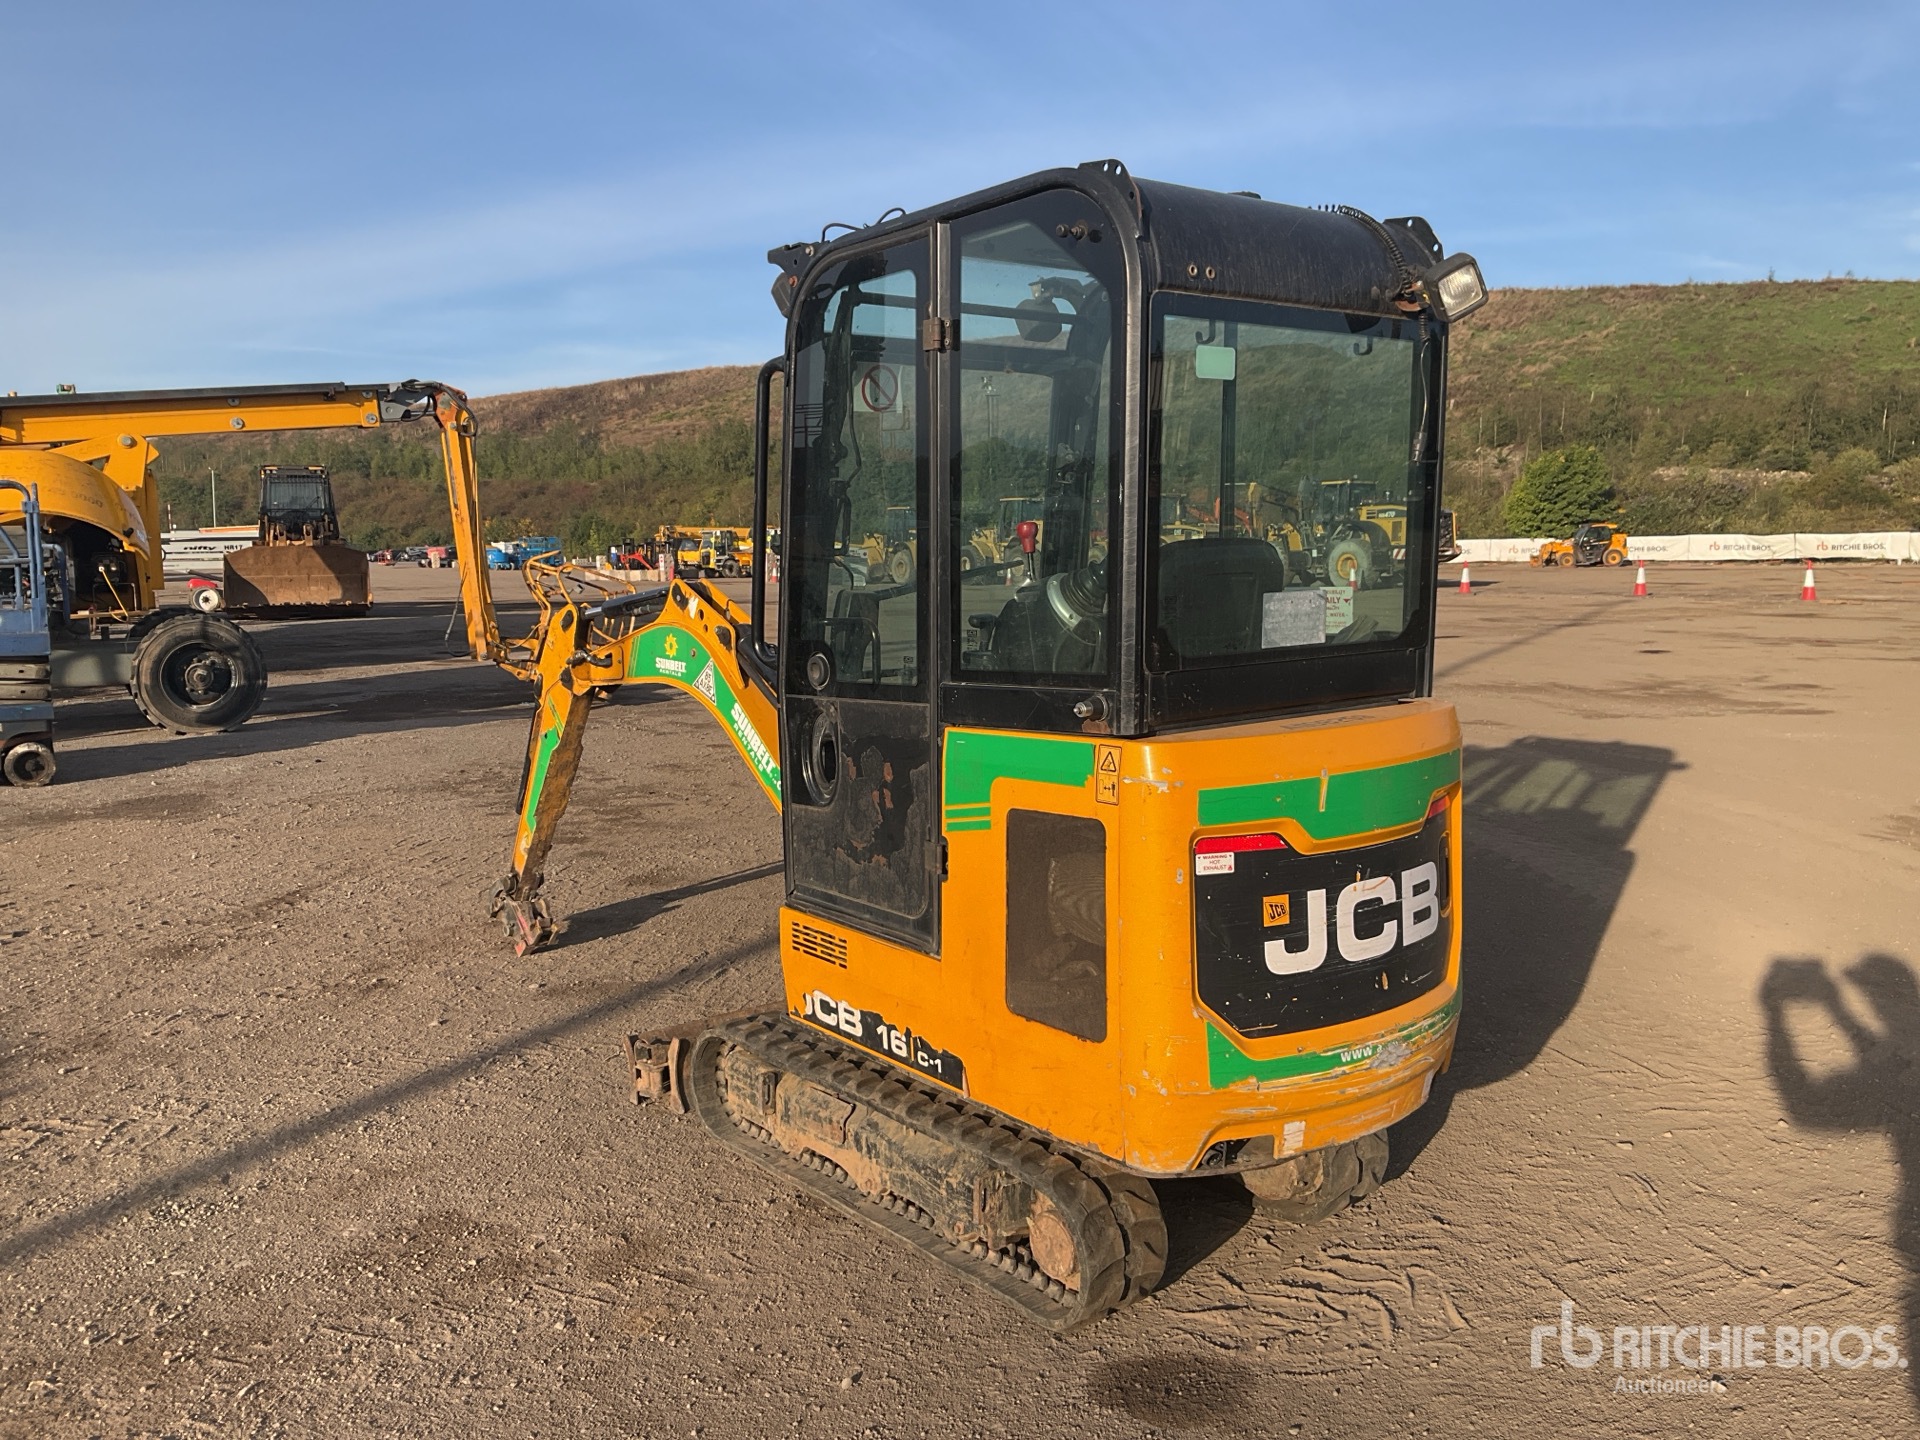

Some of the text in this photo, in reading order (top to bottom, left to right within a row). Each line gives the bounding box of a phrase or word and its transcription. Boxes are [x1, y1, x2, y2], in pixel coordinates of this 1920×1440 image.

[1710, 541, 1720, 550] rb
[1817, 541, 1828, 550] rb
[656, 657, 686, 673] SUNBELT
[731, 702, 776, 776] SUNBELT
[733, 722, 764, 772] RENTALS
[1264, 861, 1439, 976] JCB
[1268, 904, 1286, 920] JCB
